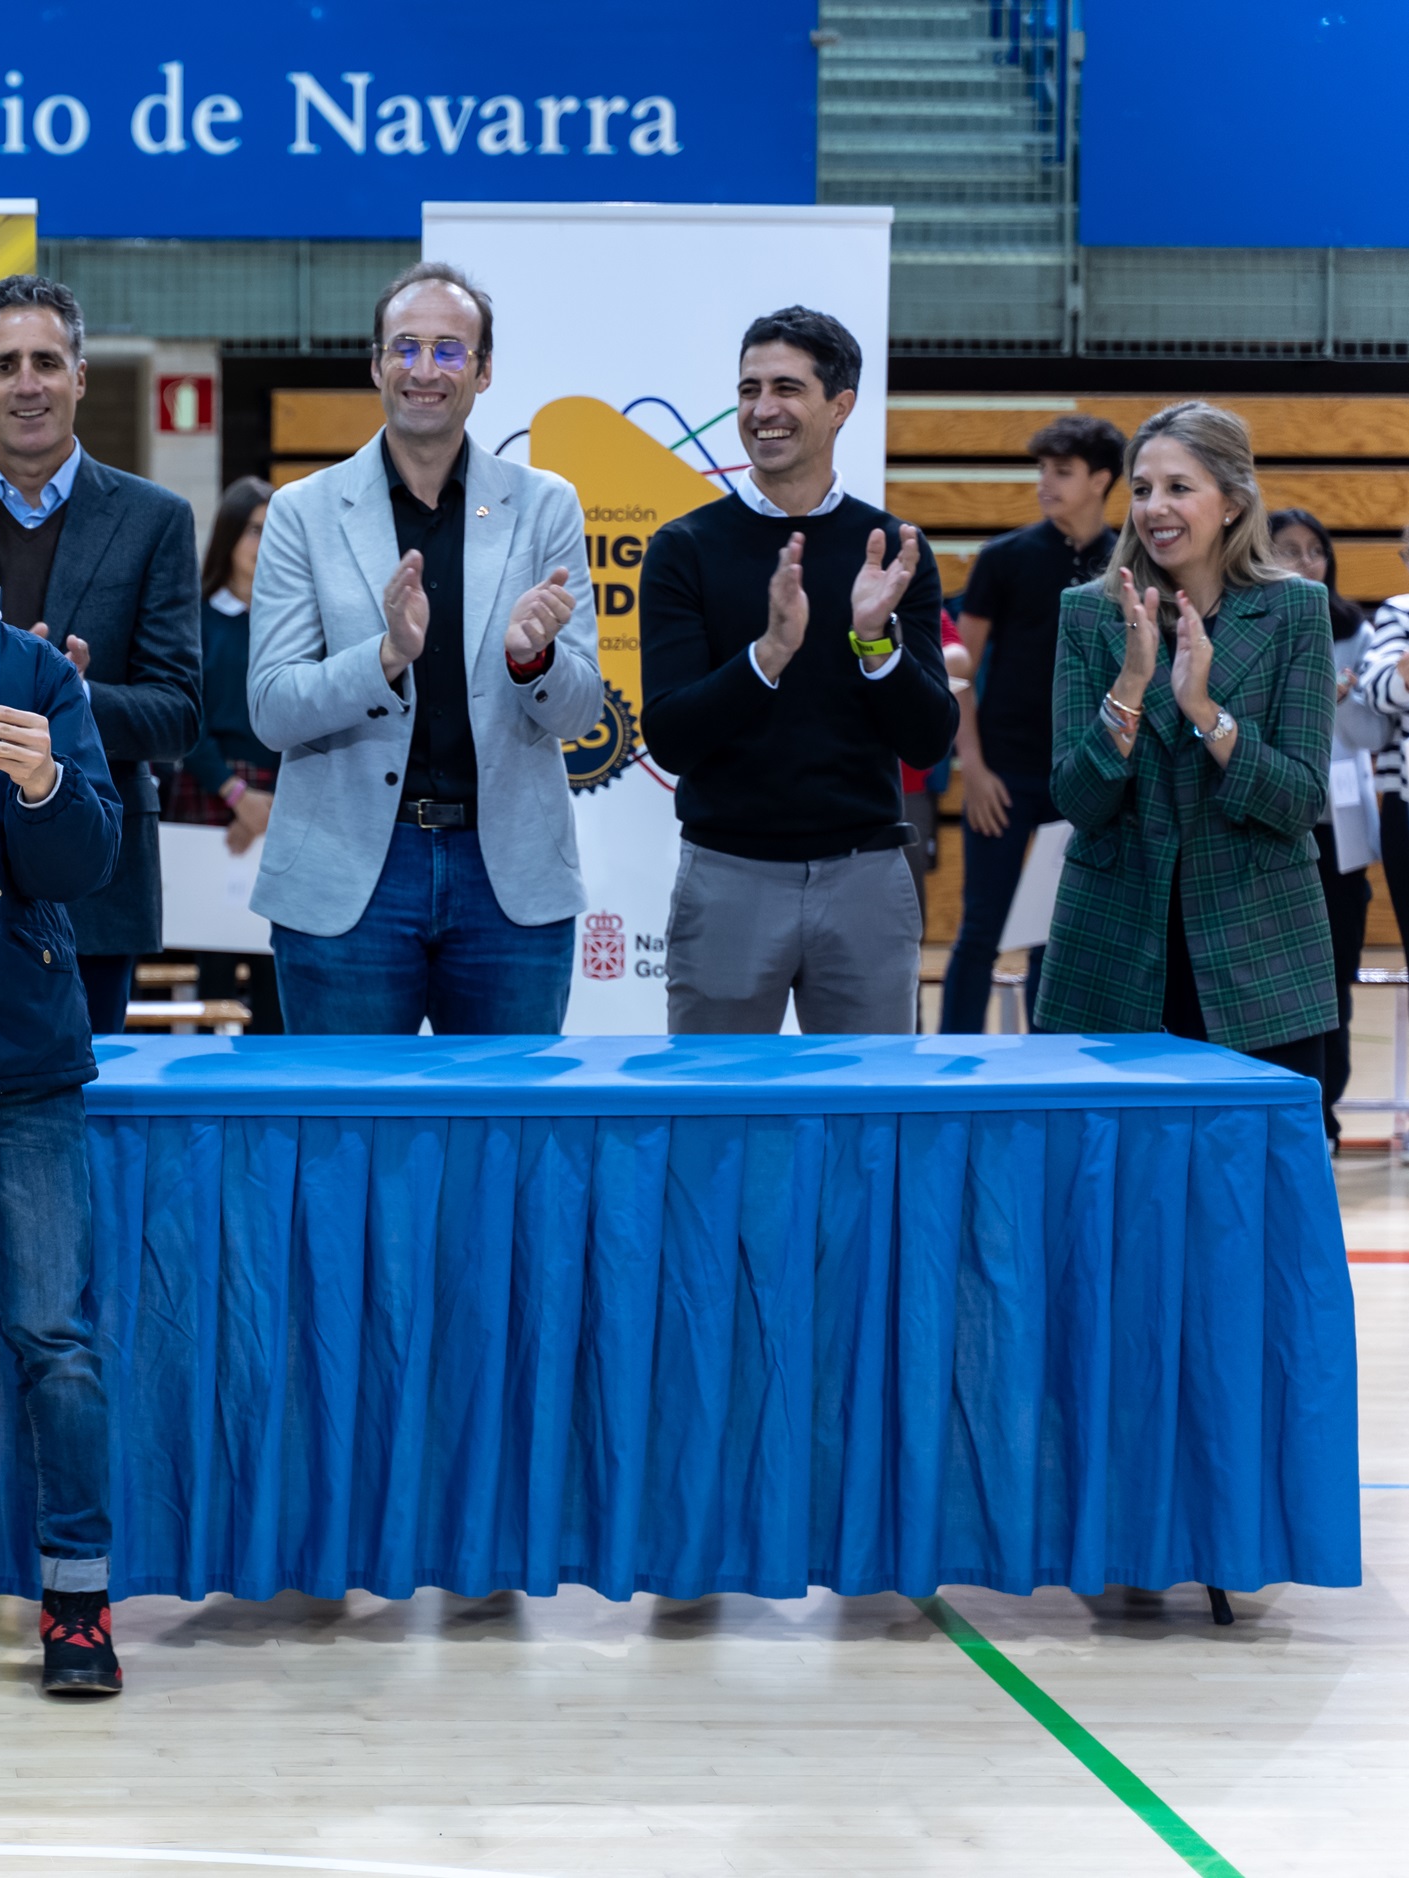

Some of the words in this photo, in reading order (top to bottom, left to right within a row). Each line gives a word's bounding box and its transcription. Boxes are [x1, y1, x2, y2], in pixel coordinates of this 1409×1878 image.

[129, 61, 243, 156] de
[285, 70, 686, 156] Navarra
[584, 504, 657, 523] dación
